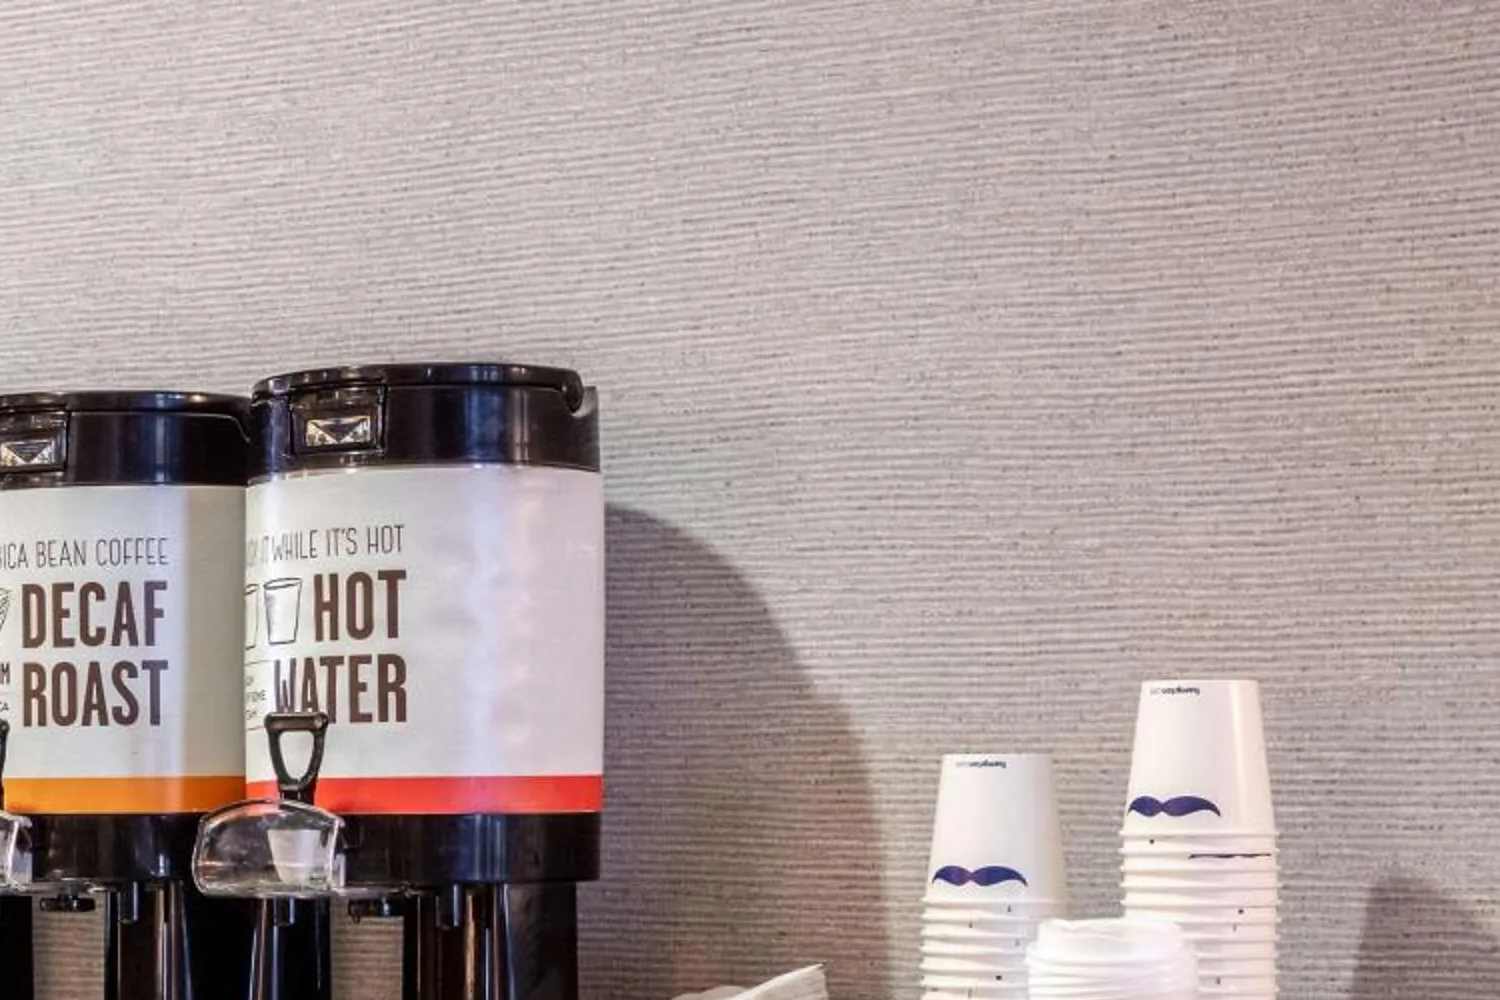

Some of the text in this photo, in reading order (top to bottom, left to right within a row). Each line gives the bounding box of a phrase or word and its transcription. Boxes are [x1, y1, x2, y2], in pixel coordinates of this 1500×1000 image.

[35, 540, 87, 569] BEAN
[95, 537, 169, 567] COFFEE
[271, 529, 318, 561] WHILE
[326, 527, 358, 557] IT'S
[367, 524, 405, 555] HOT
[21, 580, 168, 649] DECAF
[313, 569, 407, 642] HOT
[22, 659, 169, 728] ROAST
[274, 653, 408, 724] WATER
